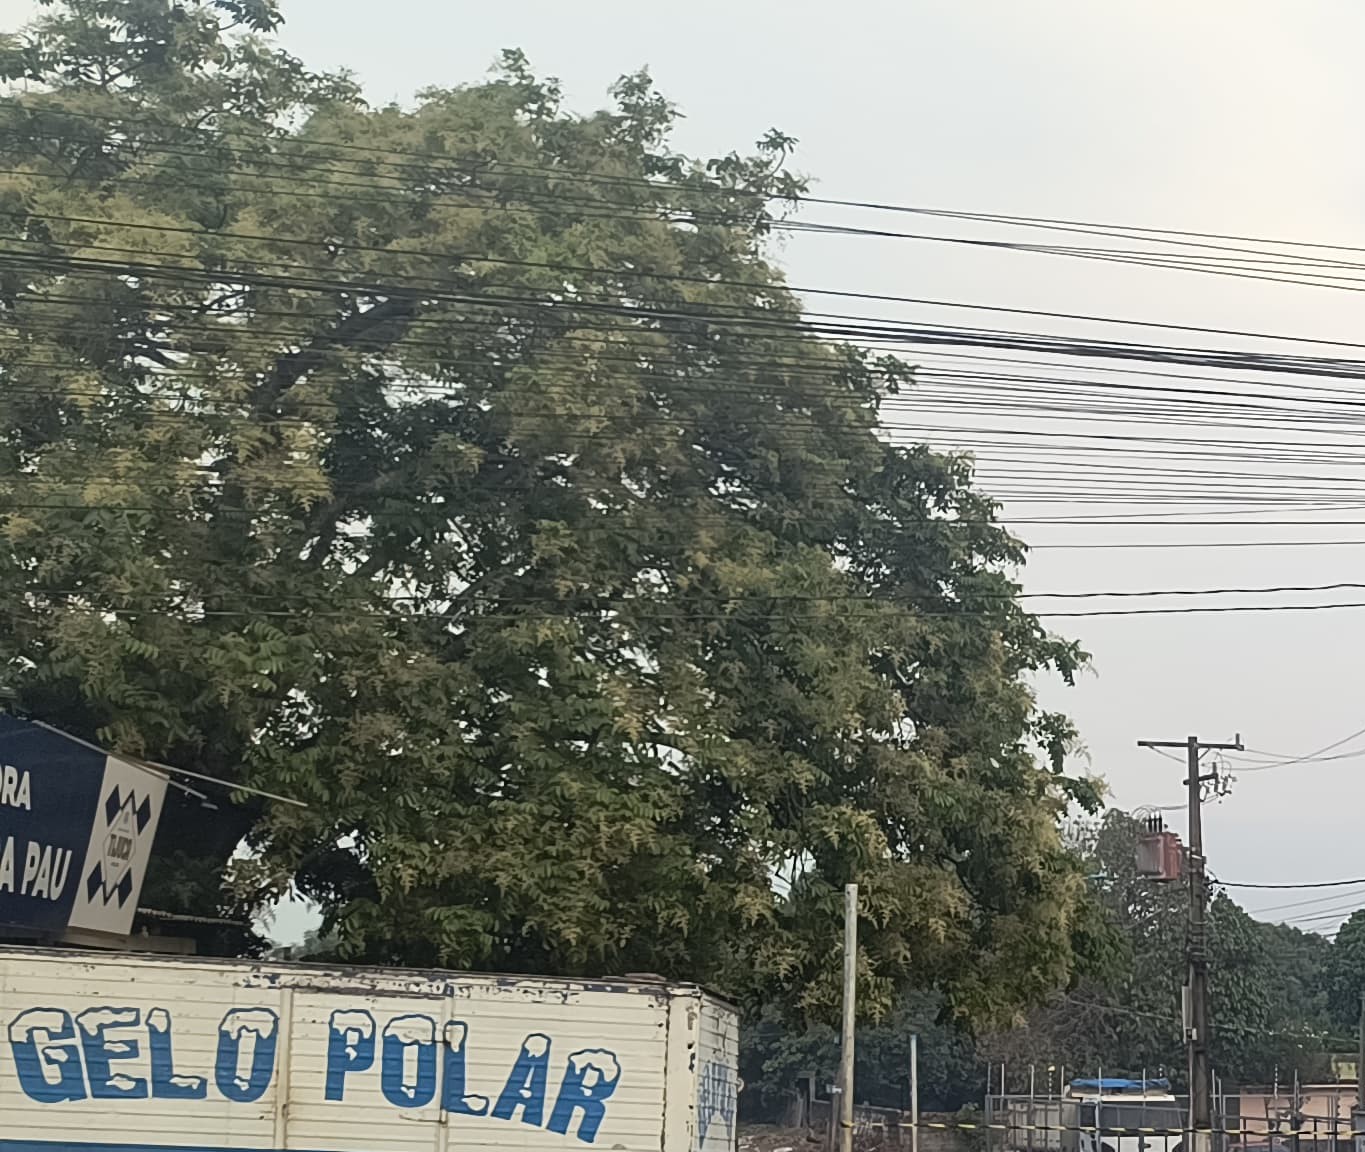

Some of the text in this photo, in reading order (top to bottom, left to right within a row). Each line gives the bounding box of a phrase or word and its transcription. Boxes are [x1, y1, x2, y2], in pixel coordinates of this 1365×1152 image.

[20, 841, 72, 901] PAU
[9, 1007, 279, 1104] GELO
[326, 1009, 621, 1143] POLAR
